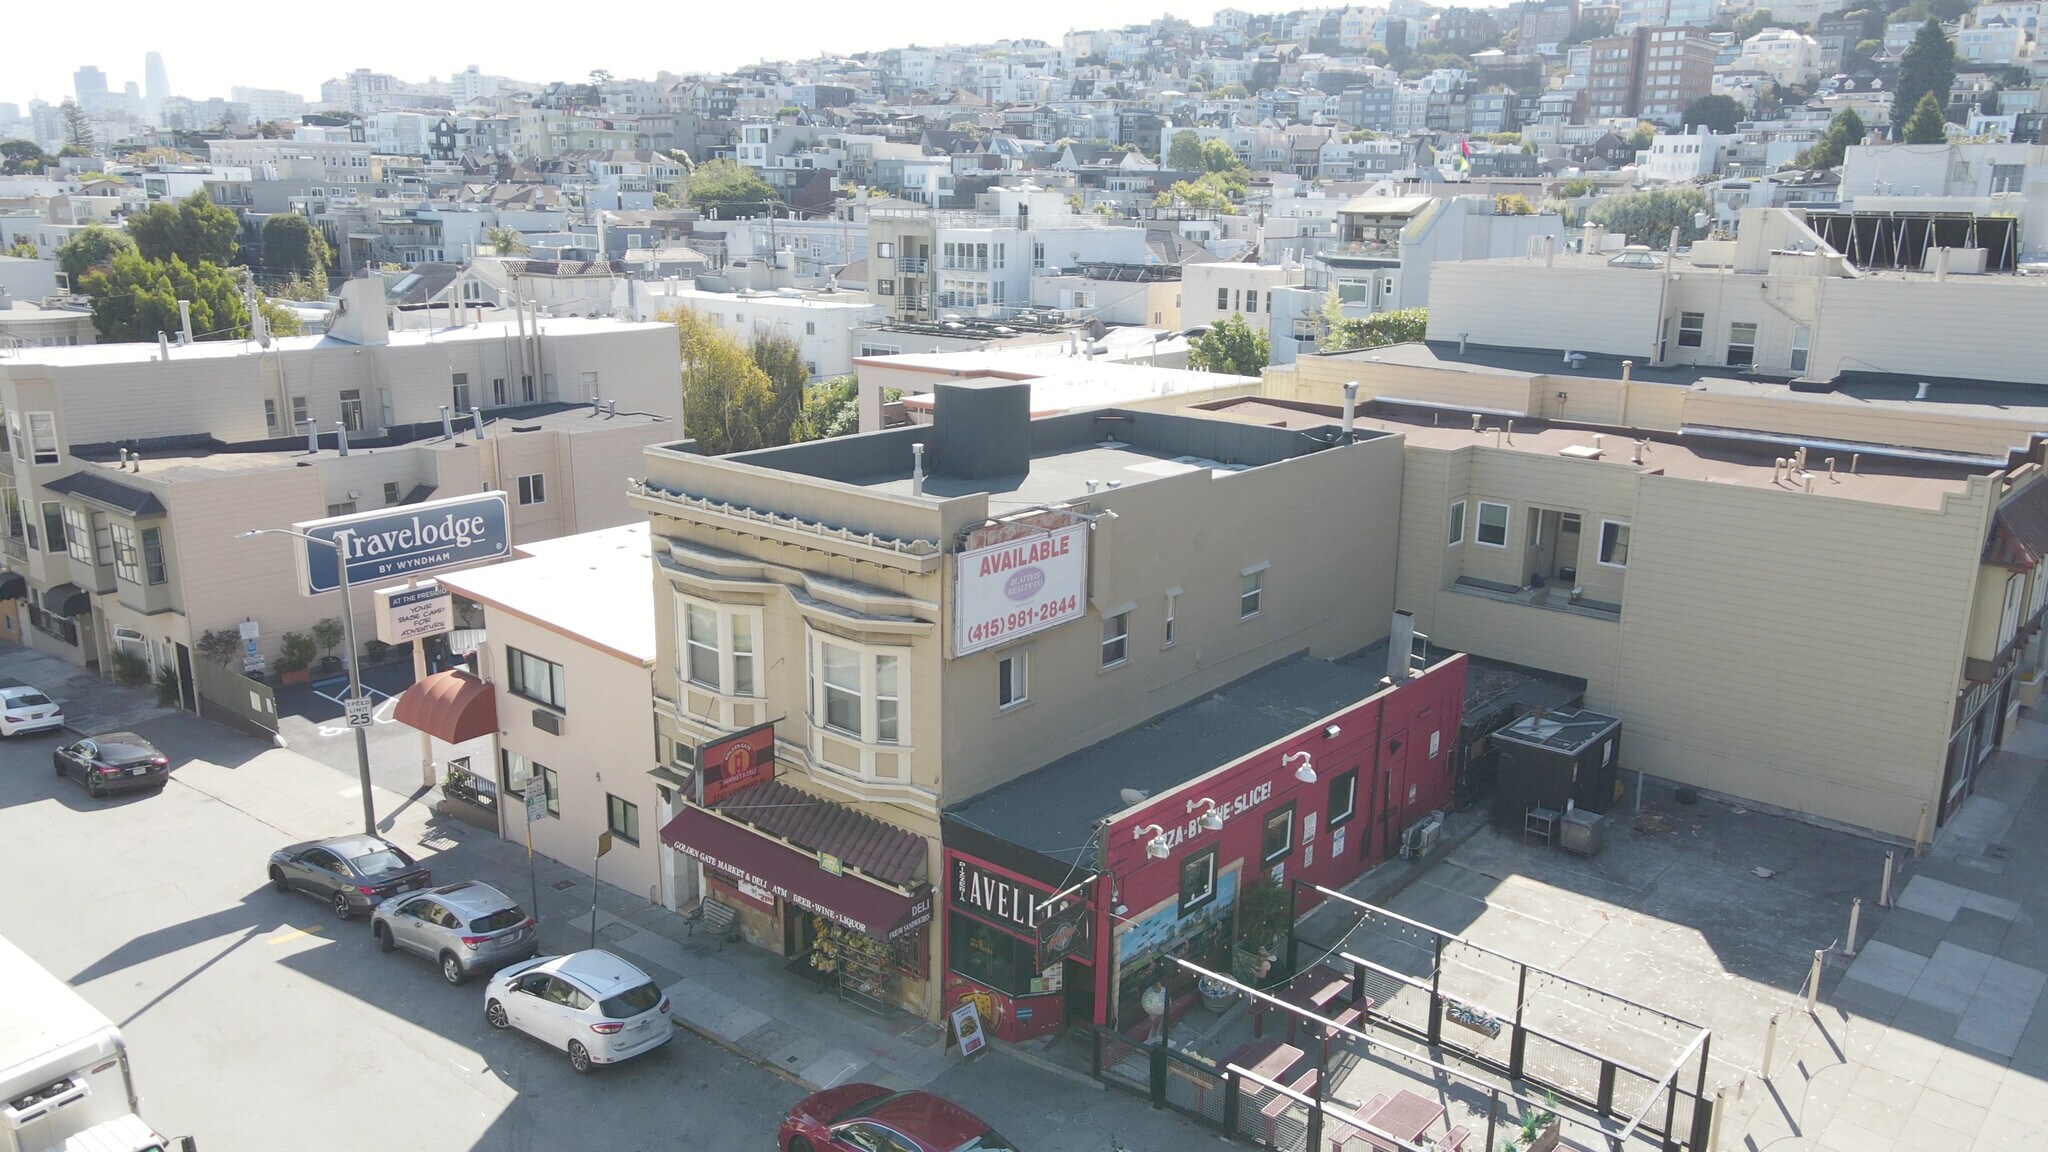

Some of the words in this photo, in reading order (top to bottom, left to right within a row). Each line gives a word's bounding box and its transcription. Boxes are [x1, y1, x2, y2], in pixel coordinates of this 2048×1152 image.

[333, 514, 485, 559] Travelodge
[379, 564, 392, 574] BY
[397, 552, 451, 569] WYNDHAM
[979, 535, 1070, 577] AVAILABLE
[393, 597, 402, 605] AT
[403, 594, 416, 603] THE
[417, 588, 447, 600] PRESIDIO
[1007, 581, 1034, 596] REALTY
[398, 614, 420, 623] BASE
[423, 607, 445, 617] CAMP
[410, 603, 432, 613] YOUR
[413, 617, 431, 627] FOR
[968, 617, 1005, 643] (415)
[1008, 595, 1076, 631] 981-2844
[401, 621, 445, 637] ADVENTURE
[350, 713, 370, 725] 25
[724, 744, 740, 761] GOLDEN
[741, 743, 752, 751] GATE
[723, 773, 744, 785] MARKET
[746, 768, 757, 777] DELI
[1233, 780, 1272, 815] SLICE!
[674, 841, 699, 858] GOLDEN
[700, 852, 717, 866] GATE
[717, 860, 745, 879] MARKET
[745, 872, 751, 881] &
[752, 876, 768, 889] DELI
[772, 885, 788, 898] ATM
[793, 894, 812, 908] BEER
[815, 903, 835, 919] WINE
[839, 914, 867, 932] LIQUOR
[958, 861, 966, 903] PIZZERIA
[911, 899, 930, 916] DELI
[888, 926, 904, 940] FRESH
